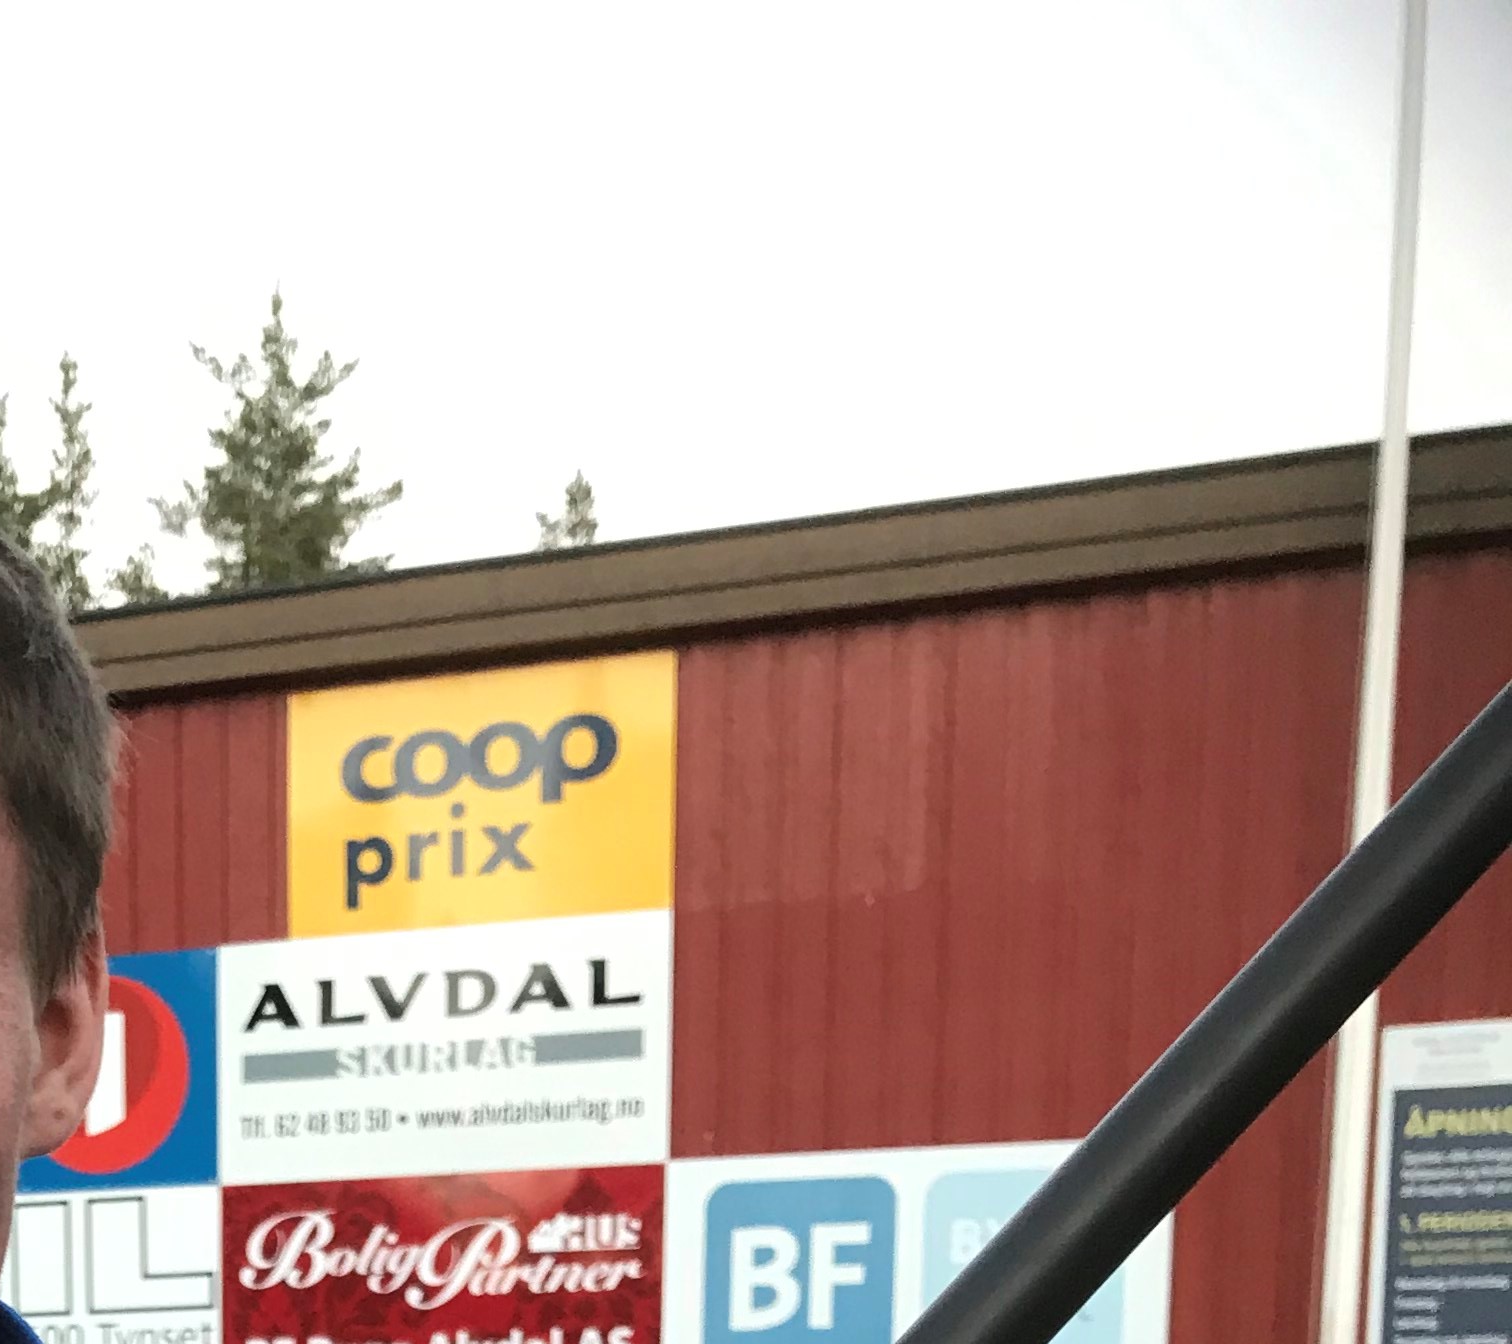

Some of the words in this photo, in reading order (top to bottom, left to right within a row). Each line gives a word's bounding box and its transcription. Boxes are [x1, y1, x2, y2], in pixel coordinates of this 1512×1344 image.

[341, 713, 619, 803] coop
[347, 803, 535, 910] prix
[244, 959, 645, 1033] ALVDAL
[337, 1034, 538, 1078] SKURLAG
[274, 1112, 301, 1139] 62
[304, 1110, 331, 1136] 48
[365, 1106, 392, 1133] 50
[415, 1094, 646, 1131] www.alvdalskurlag.no
[728, 1221, 872, 1332] BF
[949, 1217, 1006, 1263] B
